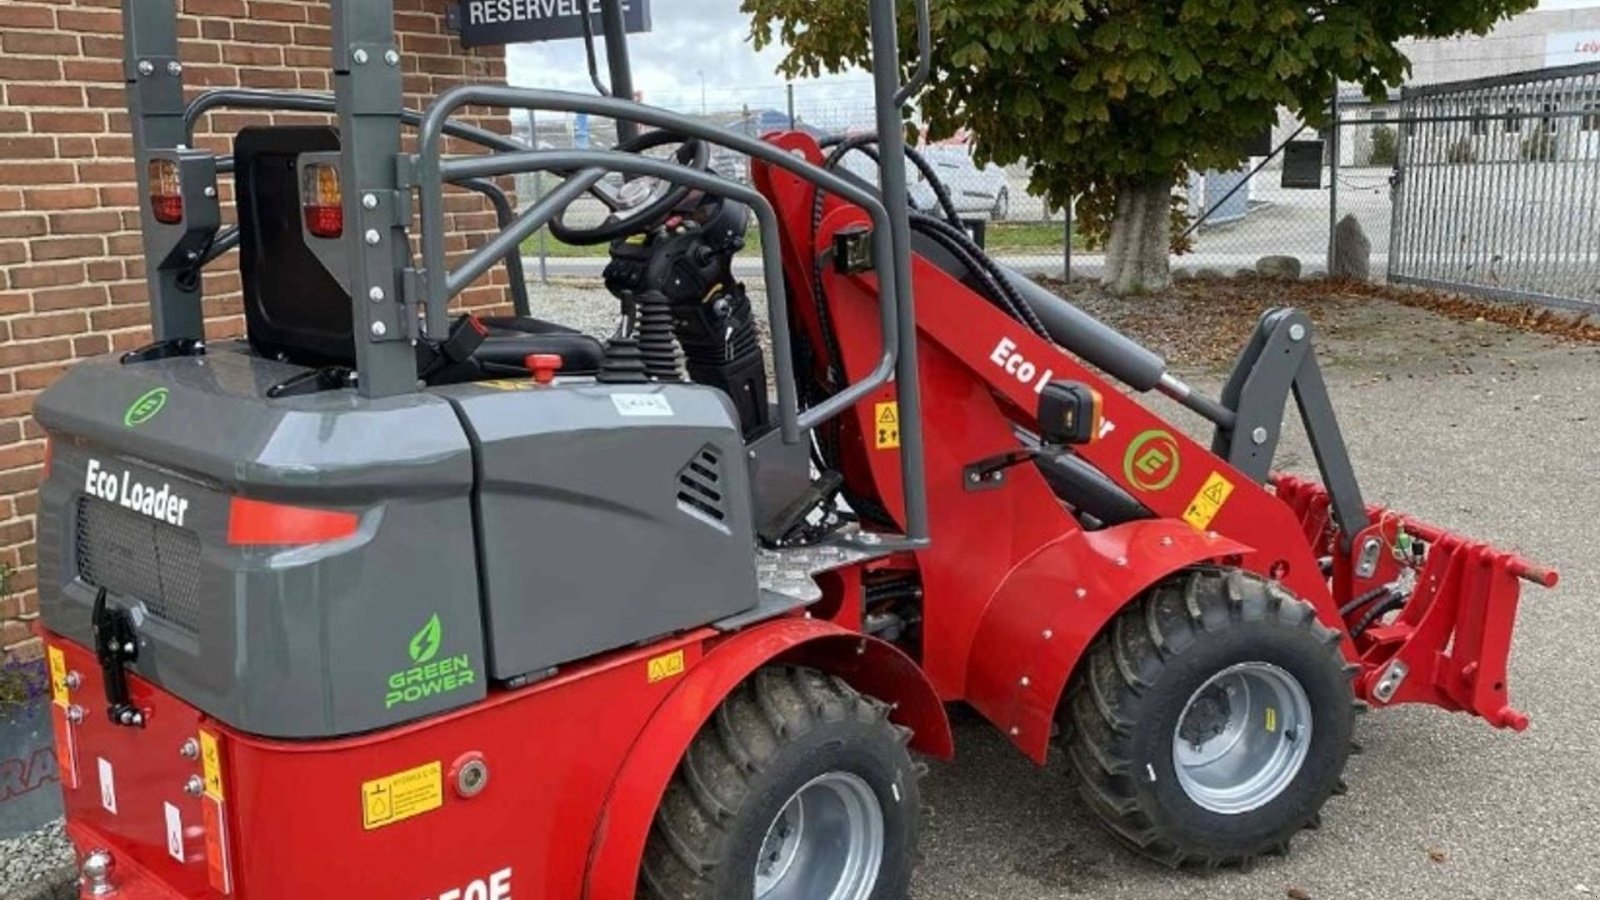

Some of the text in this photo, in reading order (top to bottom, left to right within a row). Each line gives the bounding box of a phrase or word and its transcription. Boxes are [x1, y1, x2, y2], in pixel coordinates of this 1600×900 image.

[989, 337, 1036, 384] Eco
[85, 458, 189, 526] Eco Loader
[385, 670, 475, 709] POWER
[388, 653, 468, 688] GREEN
